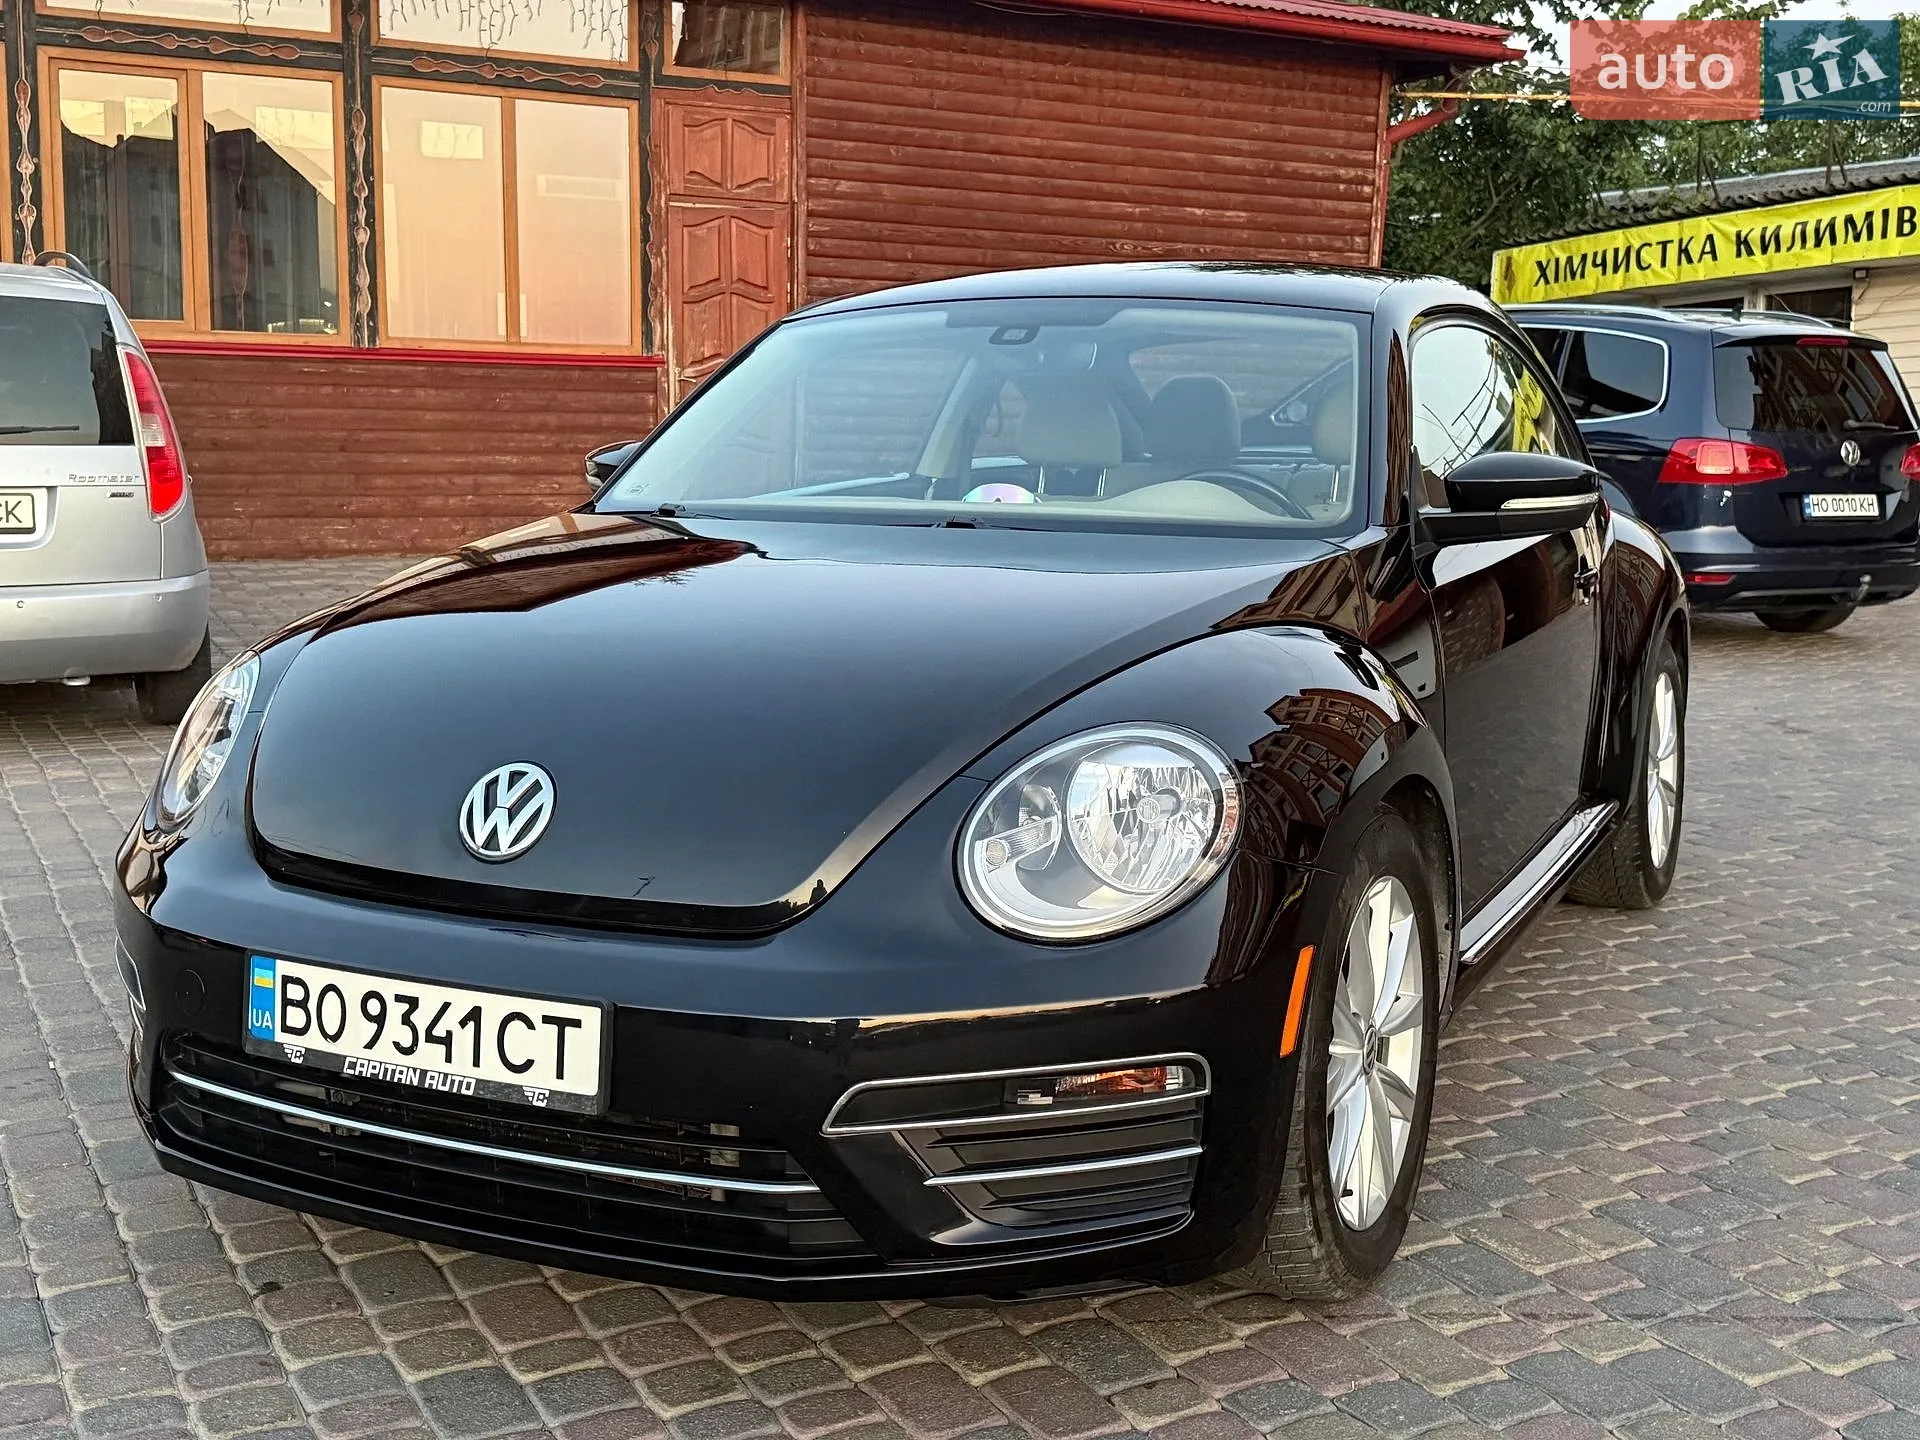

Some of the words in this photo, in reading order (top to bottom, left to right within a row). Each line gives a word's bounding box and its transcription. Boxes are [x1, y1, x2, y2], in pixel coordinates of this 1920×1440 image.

[1533, 233, 1718, 287] ХІМЧИСТКА
[1735, 205, 1918, 259] КИЛИМІВ
[0, 500, 23, 523] K
[1831, 498, 1857, 512] 0010
[252, 1007, 273, 1030] UA
[280, 974, 347, 1044] BO
[360, 990, 482, 1068] 9341
[497, 1011, 582, 1081] CT
[343, 1056, 421, 1086] CAPITAN
[424, 1071, 477, 1096] AUTO
